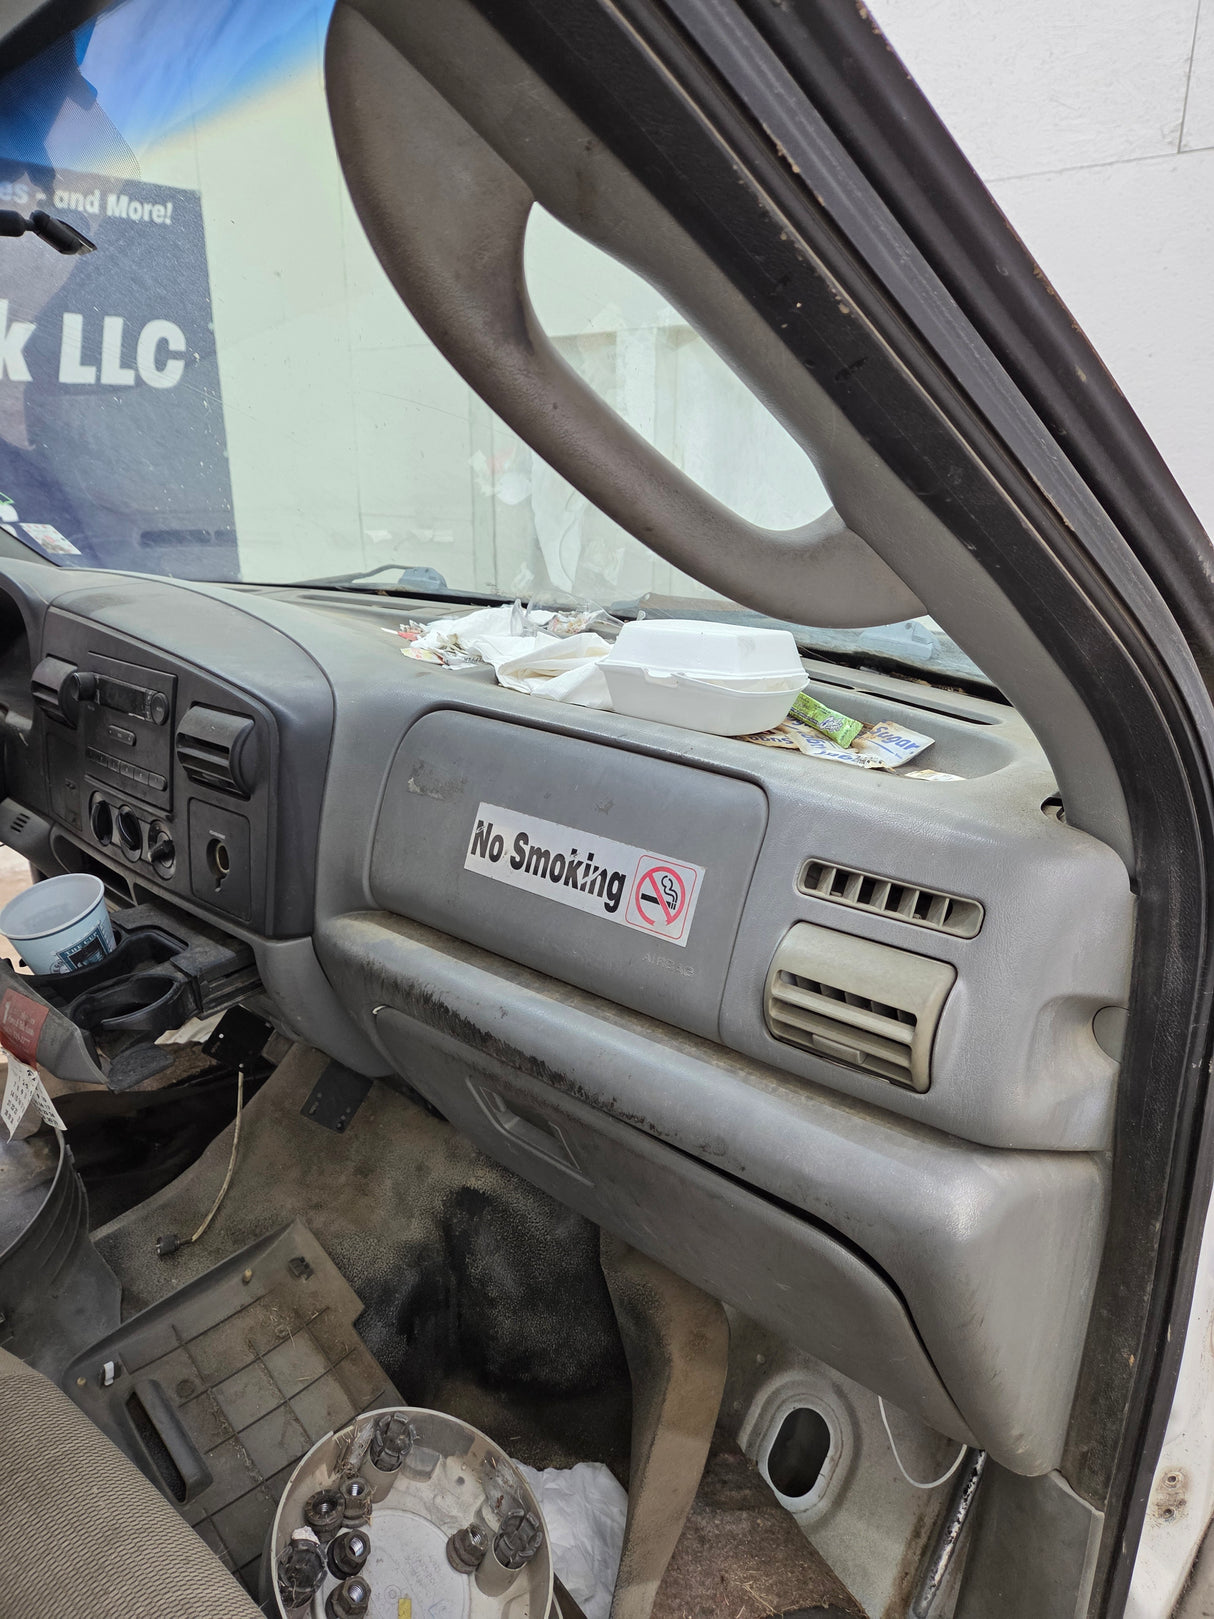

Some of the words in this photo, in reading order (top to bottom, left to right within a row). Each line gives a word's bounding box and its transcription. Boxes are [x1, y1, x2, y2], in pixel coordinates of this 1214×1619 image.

[54, 190, 100, 213] and
[106, 194, 173, 225] More!
[58, 312, 187, 390] LLC
[870, 726, 921, 753] Sugar
[470, 820, 505, 863] No
[509, 831, 627, 914] Smoking
